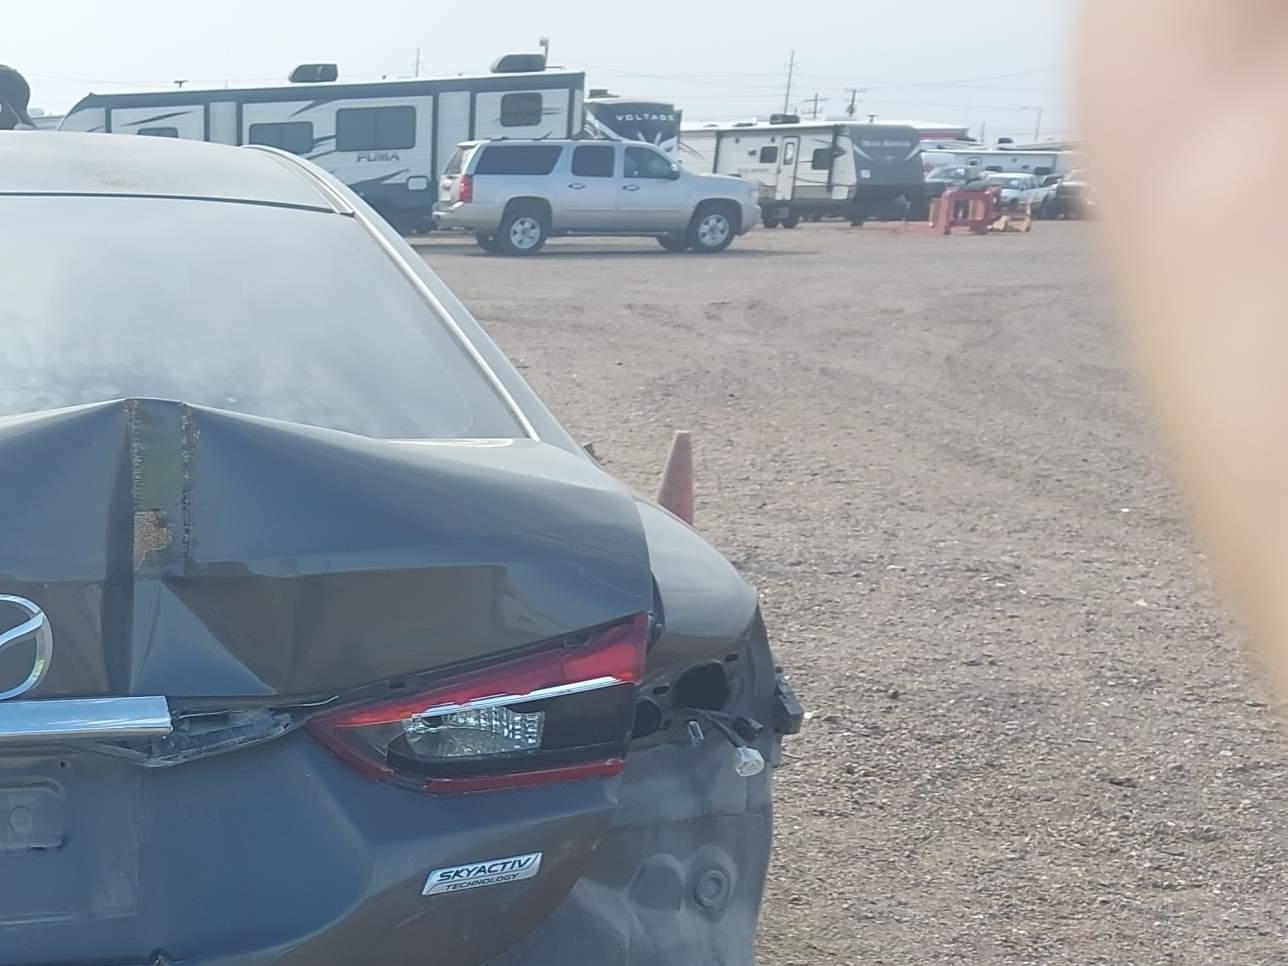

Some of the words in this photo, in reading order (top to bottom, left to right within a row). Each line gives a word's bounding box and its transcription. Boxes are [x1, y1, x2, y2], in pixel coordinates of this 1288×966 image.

[615, 113, 675, 121] VOLTAGE
[356, 152, 400, 163] PUMA
[437, 856, 532, 883] SKYACTIV
[445, 872, 520, 891] TECHNOLOGY
